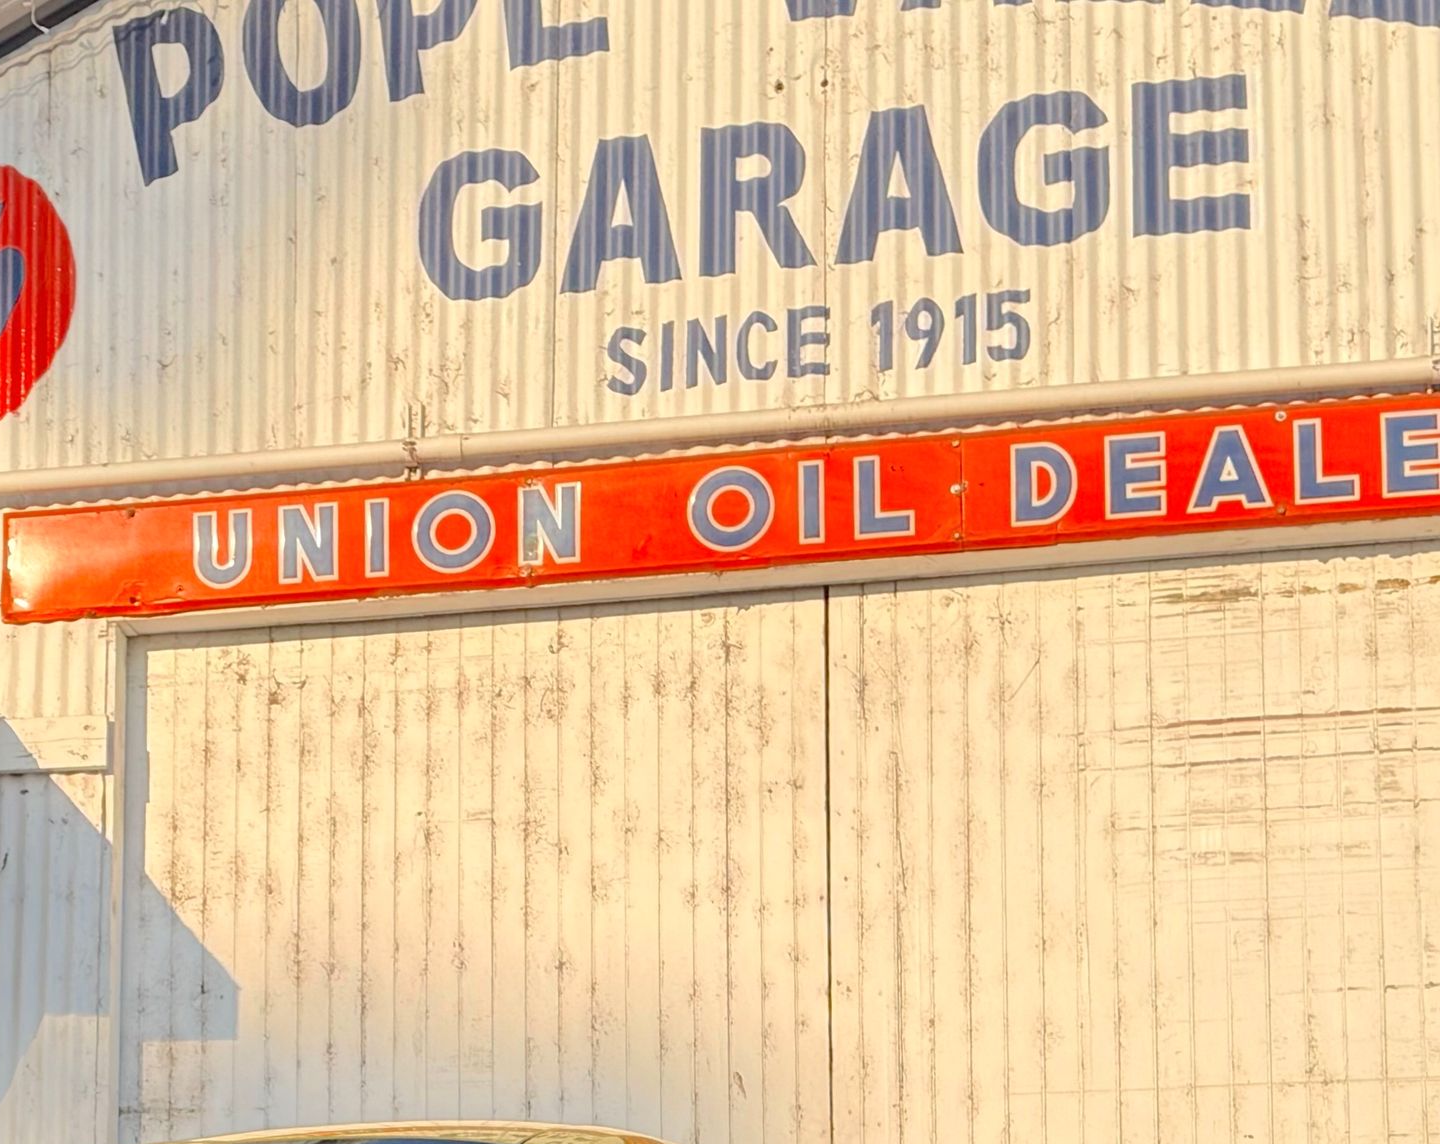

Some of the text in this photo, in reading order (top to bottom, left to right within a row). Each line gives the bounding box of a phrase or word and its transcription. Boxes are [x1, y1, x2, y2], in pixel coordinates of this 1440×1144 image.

[418, 74, 1251, 301] GARAGE
[606, 289, 1031, 396] SINCE 1915
[192, 481, 581, 590] UNION
[687, 454, 915, 552] OIL
